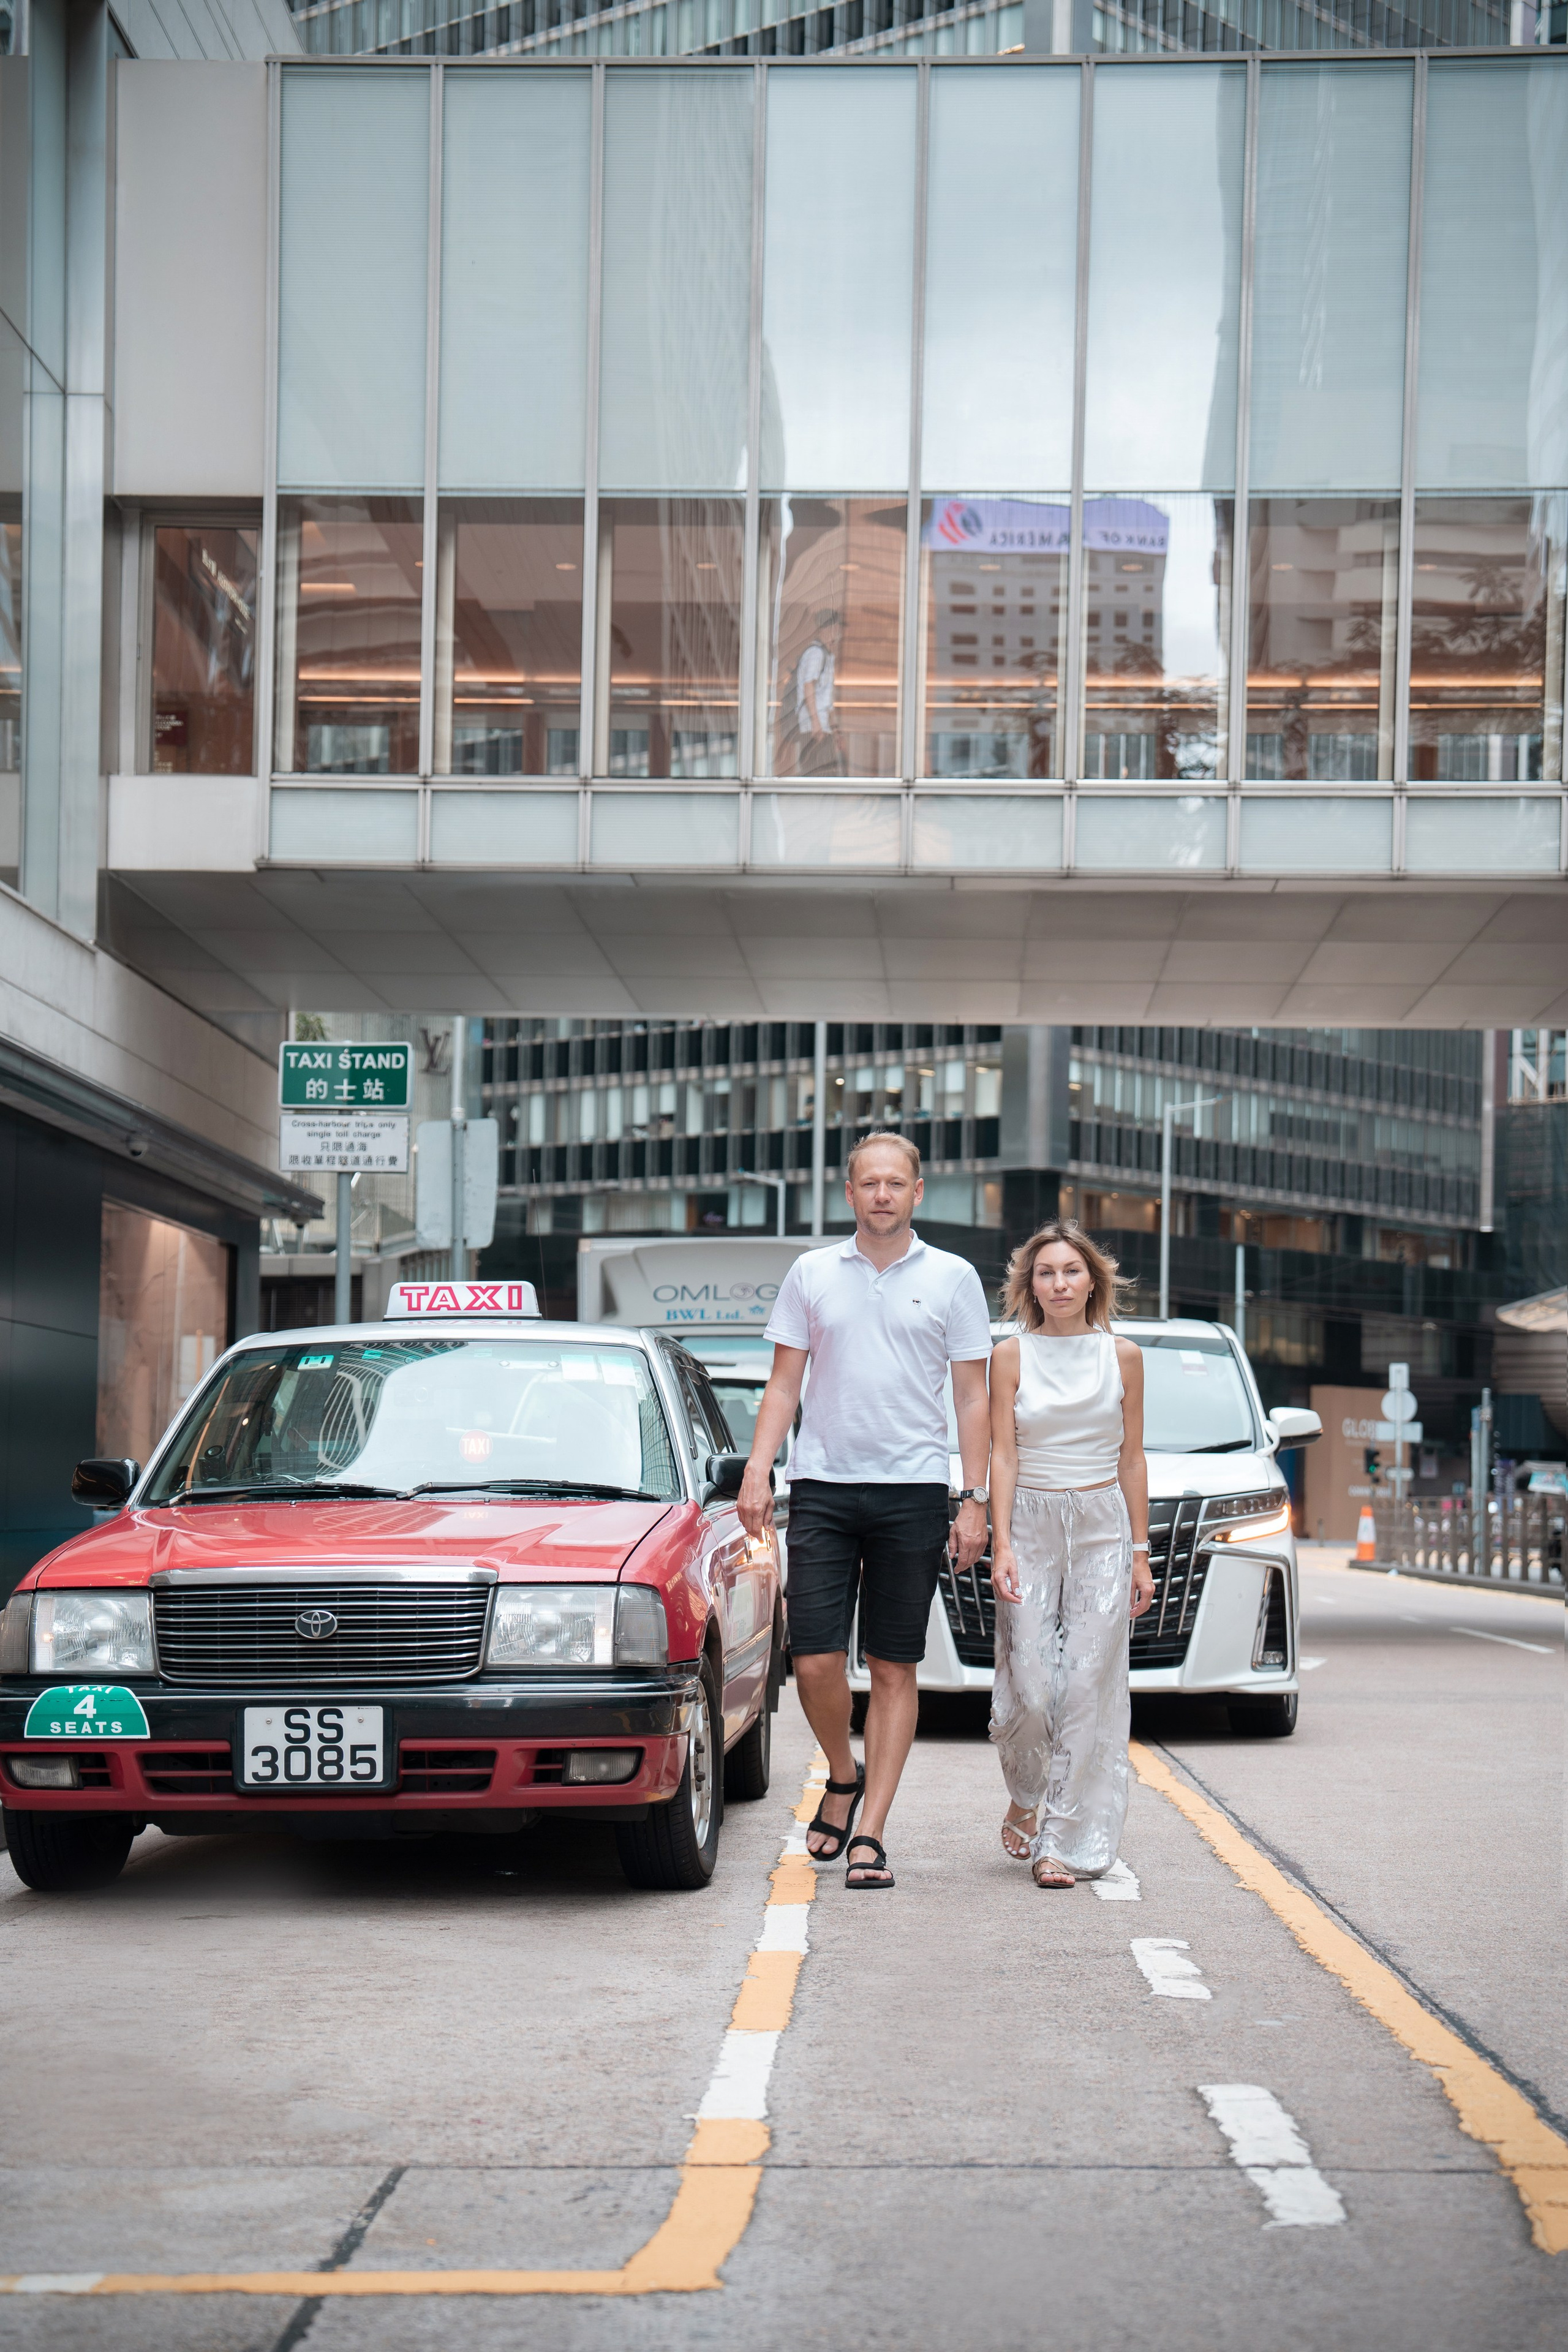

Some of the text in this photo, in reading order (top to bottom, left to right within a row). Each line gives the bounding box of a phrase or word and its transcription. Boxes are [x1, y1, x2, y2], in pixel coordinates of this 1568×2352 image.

[286, 1052, 405, 1069] TAXI STAND
[306, 1078, 385, 1101] 的士站
[292, 1120, 396, 1129] Cross-harbour trips only
[353, 1130, 381, 1139] charge
[400, 1285, 522, 1311] TAXI
[666, 1308, 744, 1321] BWL Ltd.
[462, 1438, 490, 1455] TAXI
[74, 1695, 96, 1719] 4
[50, 1722, 123, 1734] SEATS
[284, 1708, 344, 1744] SS
[251, 1744, 377, 1782] 3085
